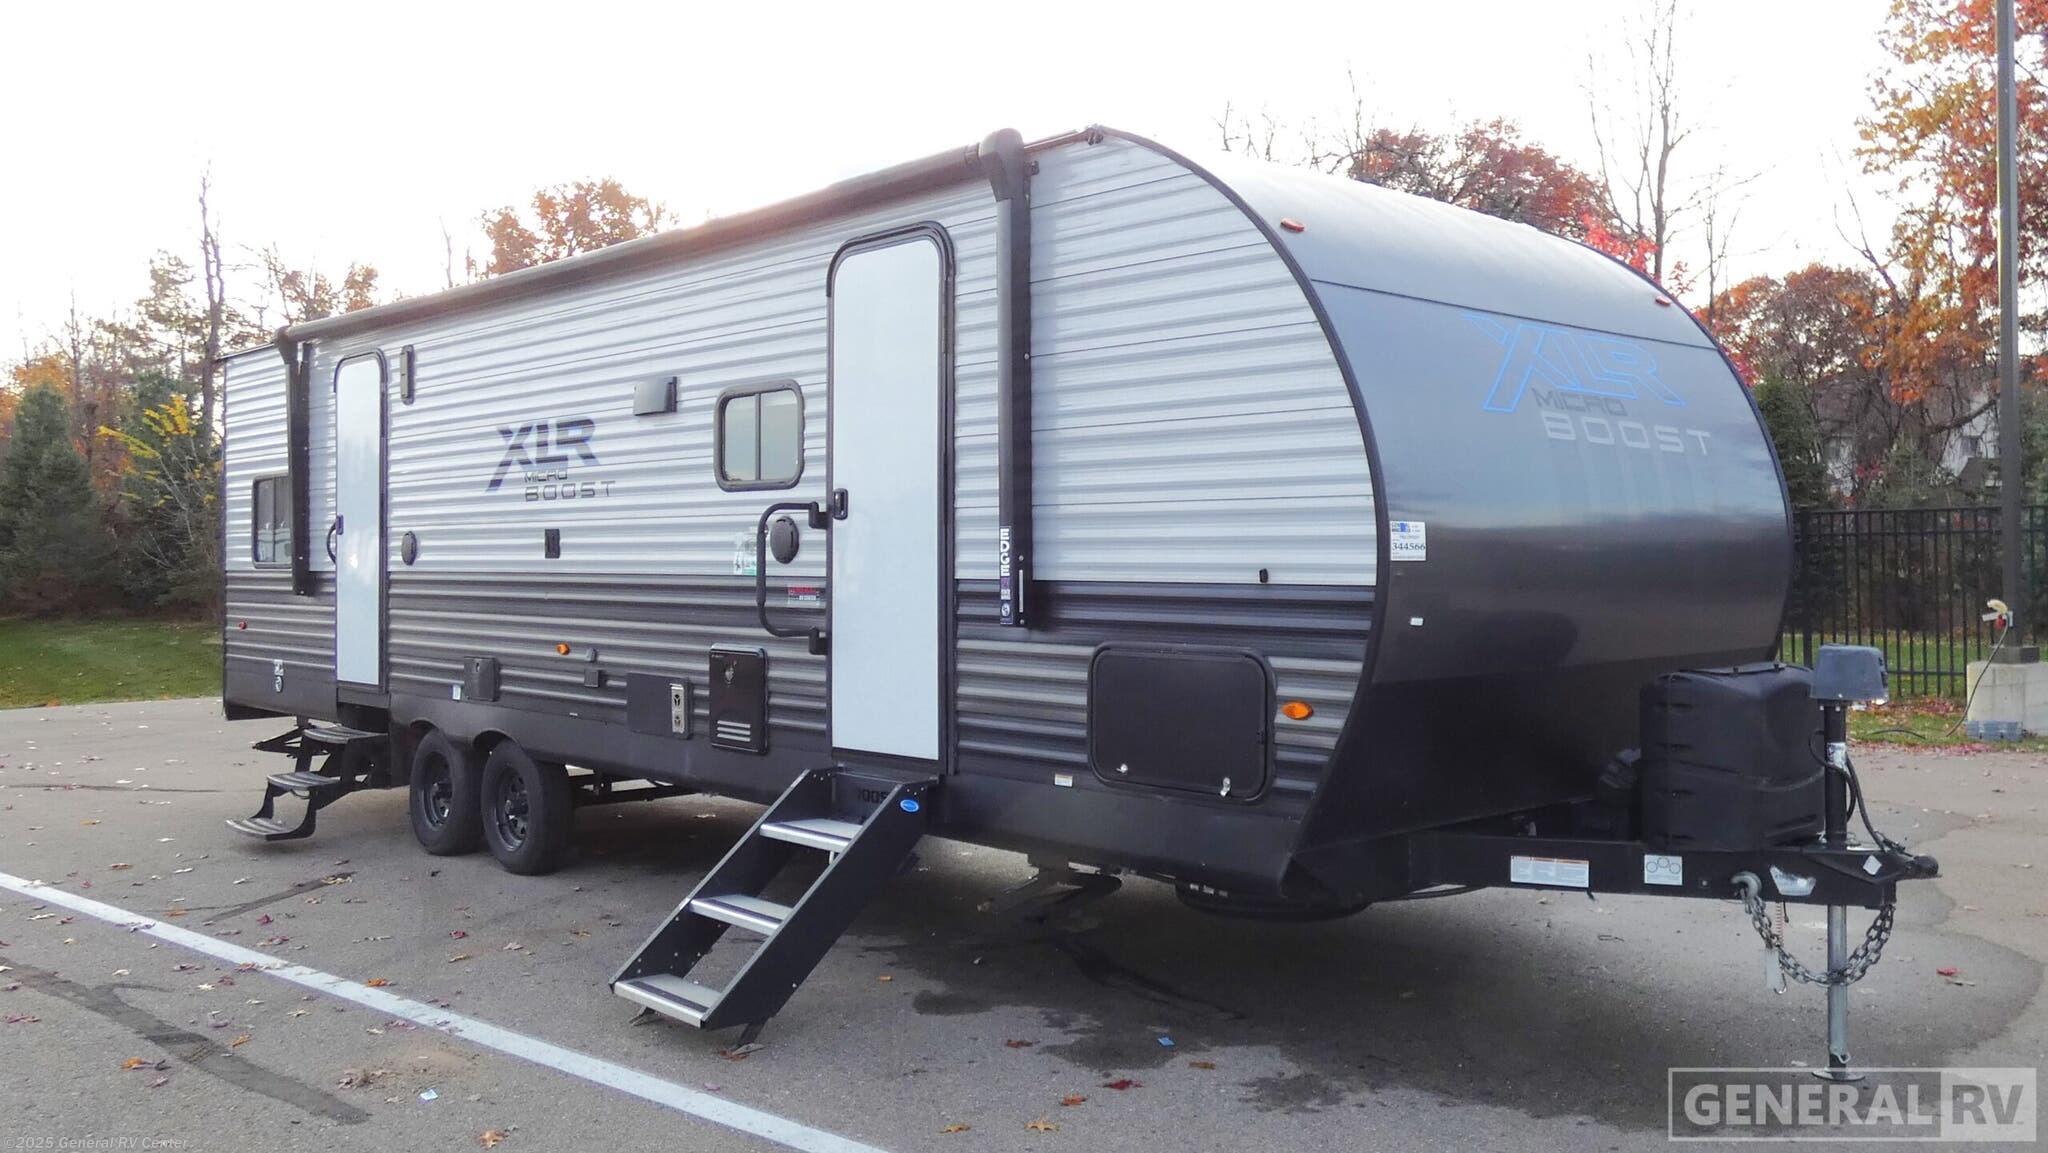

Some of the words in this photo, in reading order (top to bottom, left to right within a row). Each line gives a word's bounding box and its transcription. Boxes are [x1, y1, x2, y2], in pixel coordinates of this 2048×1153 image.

[1463, 313, 1686, 413] XLR
[1531, 387, 1628, 417] MICRO
[486, 418, 600, 492] XLR
[1539, 410, 1712, 455] BOOST
[524, 470, 568, 483] MICRO
[525, 481, 615, 501] BOOST
[1000, 528, 1010, 576] EDGE
